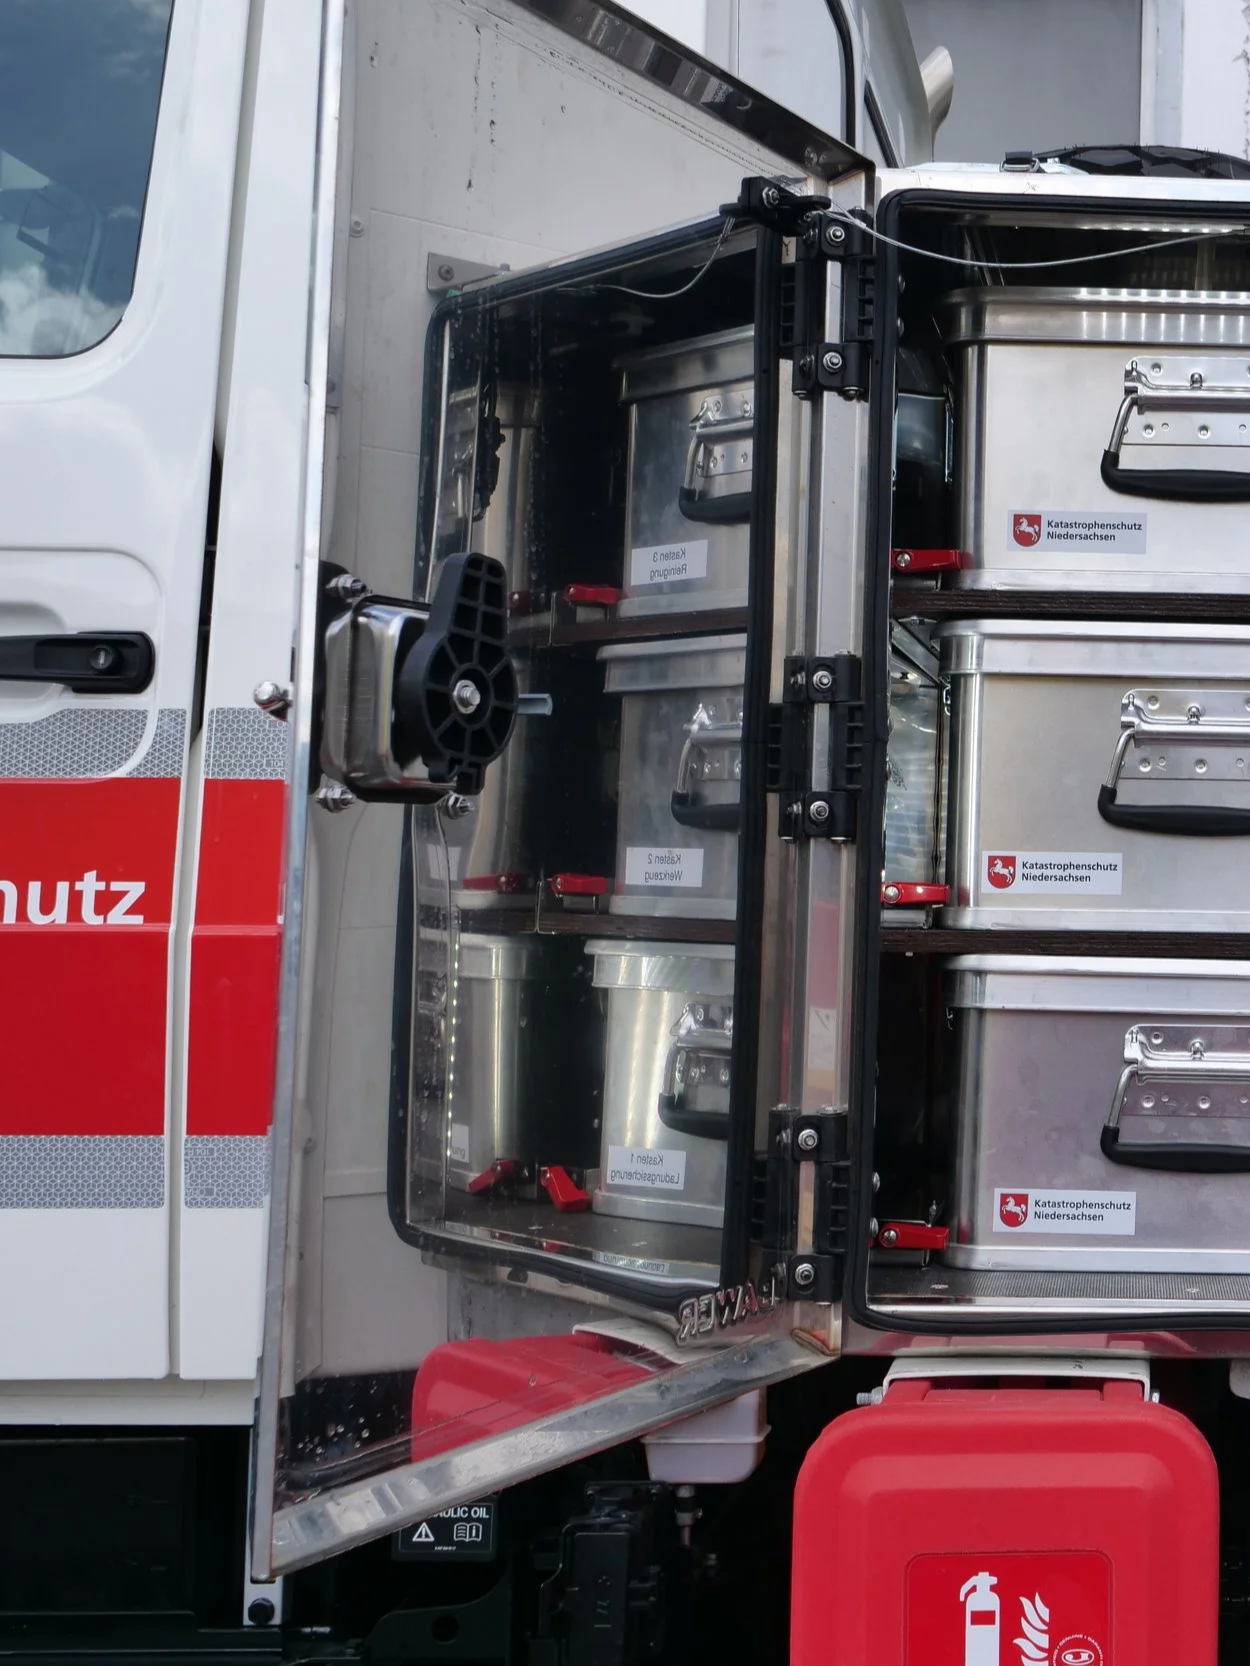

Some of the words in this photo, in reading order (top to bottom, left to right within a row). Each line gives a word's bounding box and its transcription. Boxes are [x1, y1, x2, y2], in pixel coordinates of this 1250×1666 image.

[1047, 519, 1142, 531] Katastrophenschutz
[1046, 531, 1116, 541] Niedersachsen
[1021, 861, 1118, 872] Katastrophenschutz
[1021, 872, 1091, 883] Niedersachsen
[1034, 1199, 1132, 1211] Katastrophenschutz
[1033, 1211, 1104, 1222] Niedersachsen
[471, 1506, 490, 1518] OIL
